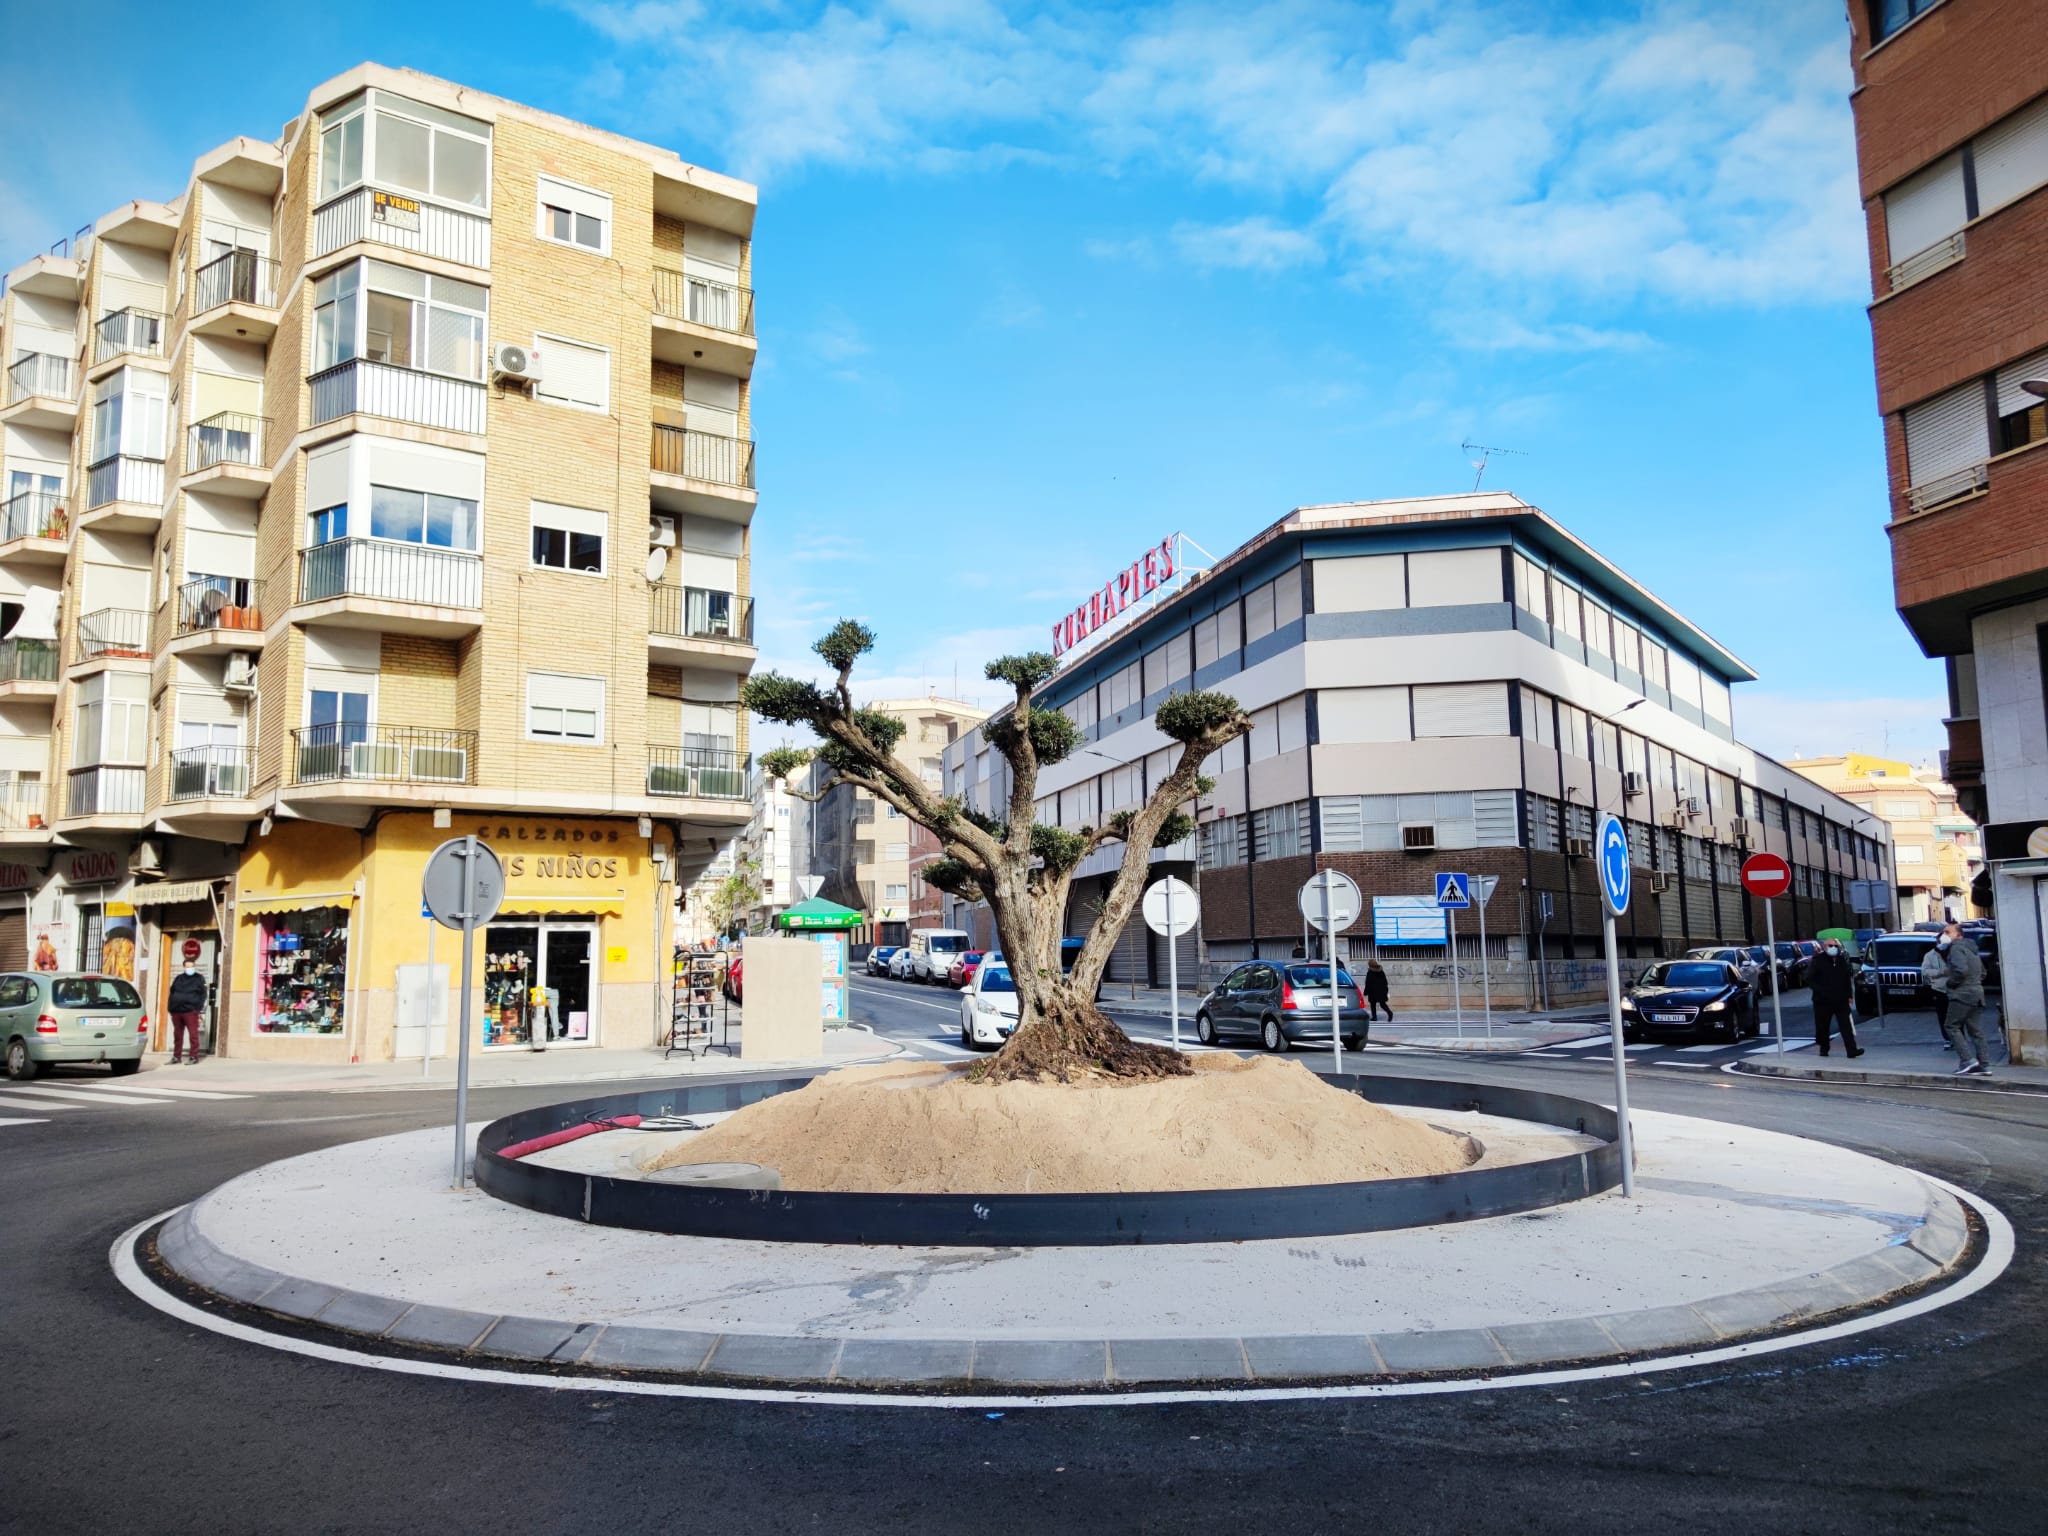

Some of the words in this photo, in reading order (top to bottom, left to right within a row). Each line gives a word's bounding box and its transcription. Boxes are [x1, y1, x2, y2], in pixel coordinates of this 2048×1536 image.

[375, 192, 386, 205] SE
[389, 196, 420, 213] VENDE
[1052, 534, 1174, 658] KURHAPIES
[477, 825, 619, 843] CALZADOS
[71, 852, 117, 880] ASADOS
[501, 855, 525, 877] IS
[536, 851, 618, 878] NIÑOS
